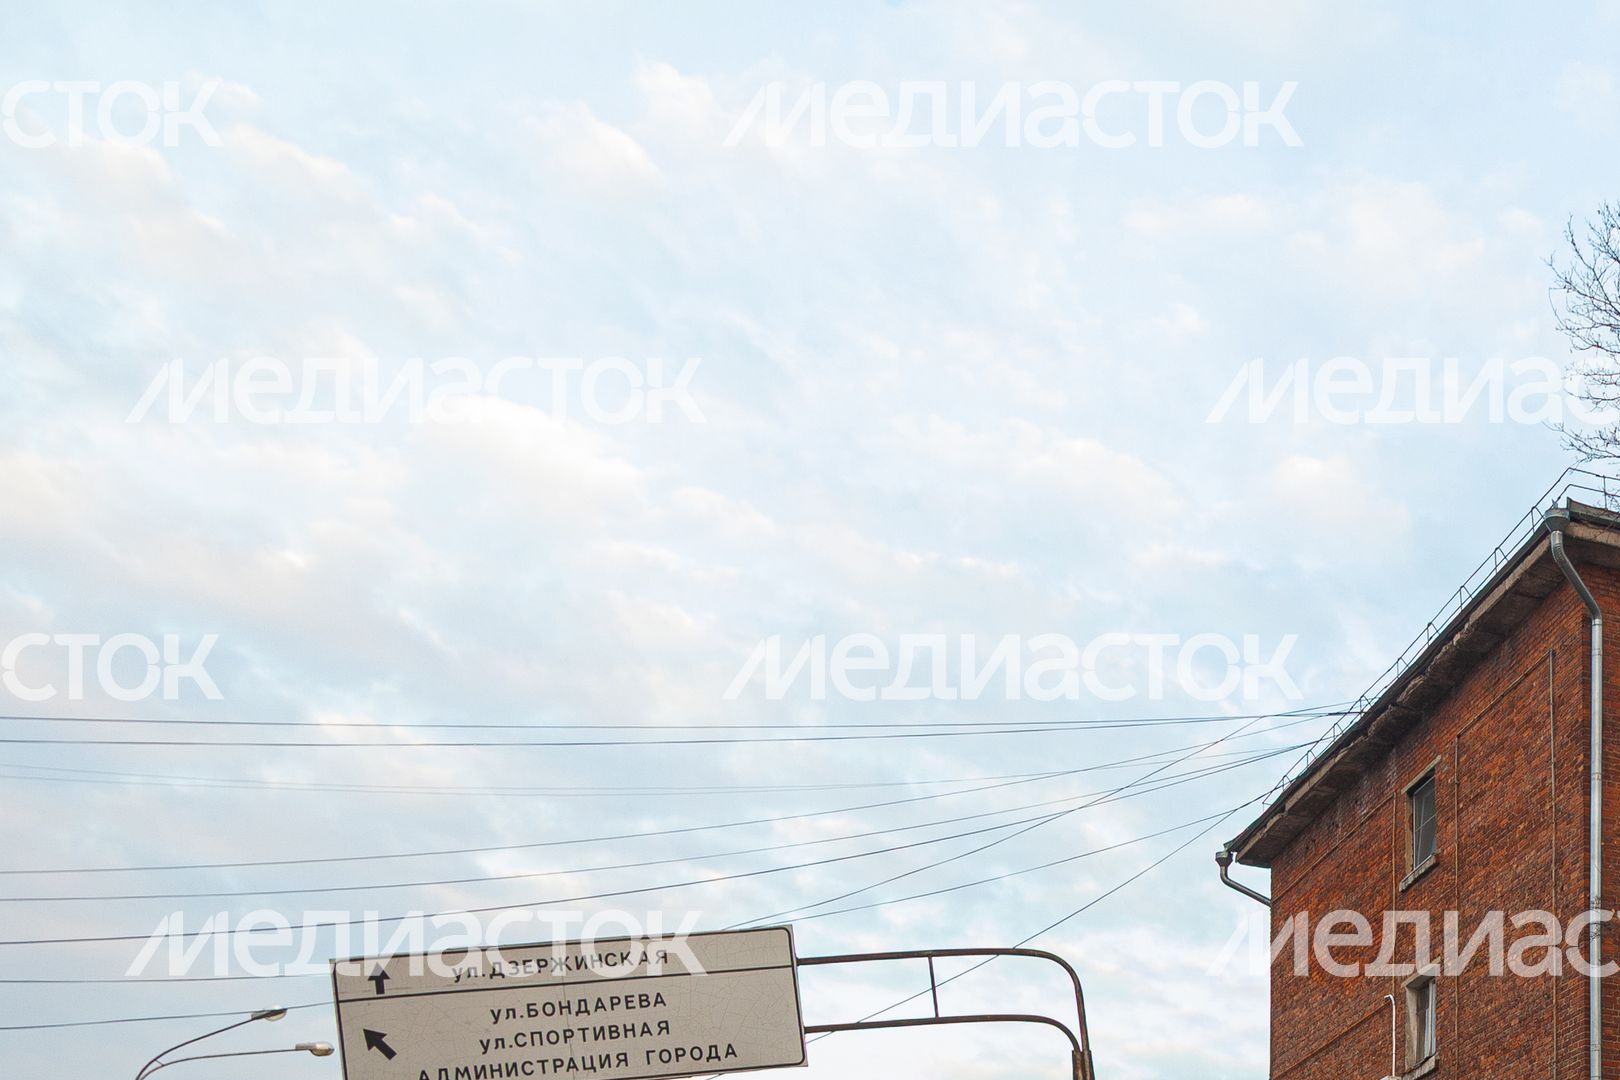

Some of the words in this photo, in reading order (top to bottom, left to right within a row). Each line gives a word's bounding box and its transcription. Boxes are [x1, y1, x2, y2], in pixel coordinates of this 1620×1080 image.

[490, 992, 667, 1024] ул.БОНДАРЕВА
[479, 1020, 671, 1055] ул.СПОРТИВНАЯ
[645, 1043, 738, 1065] ГОРОДА
